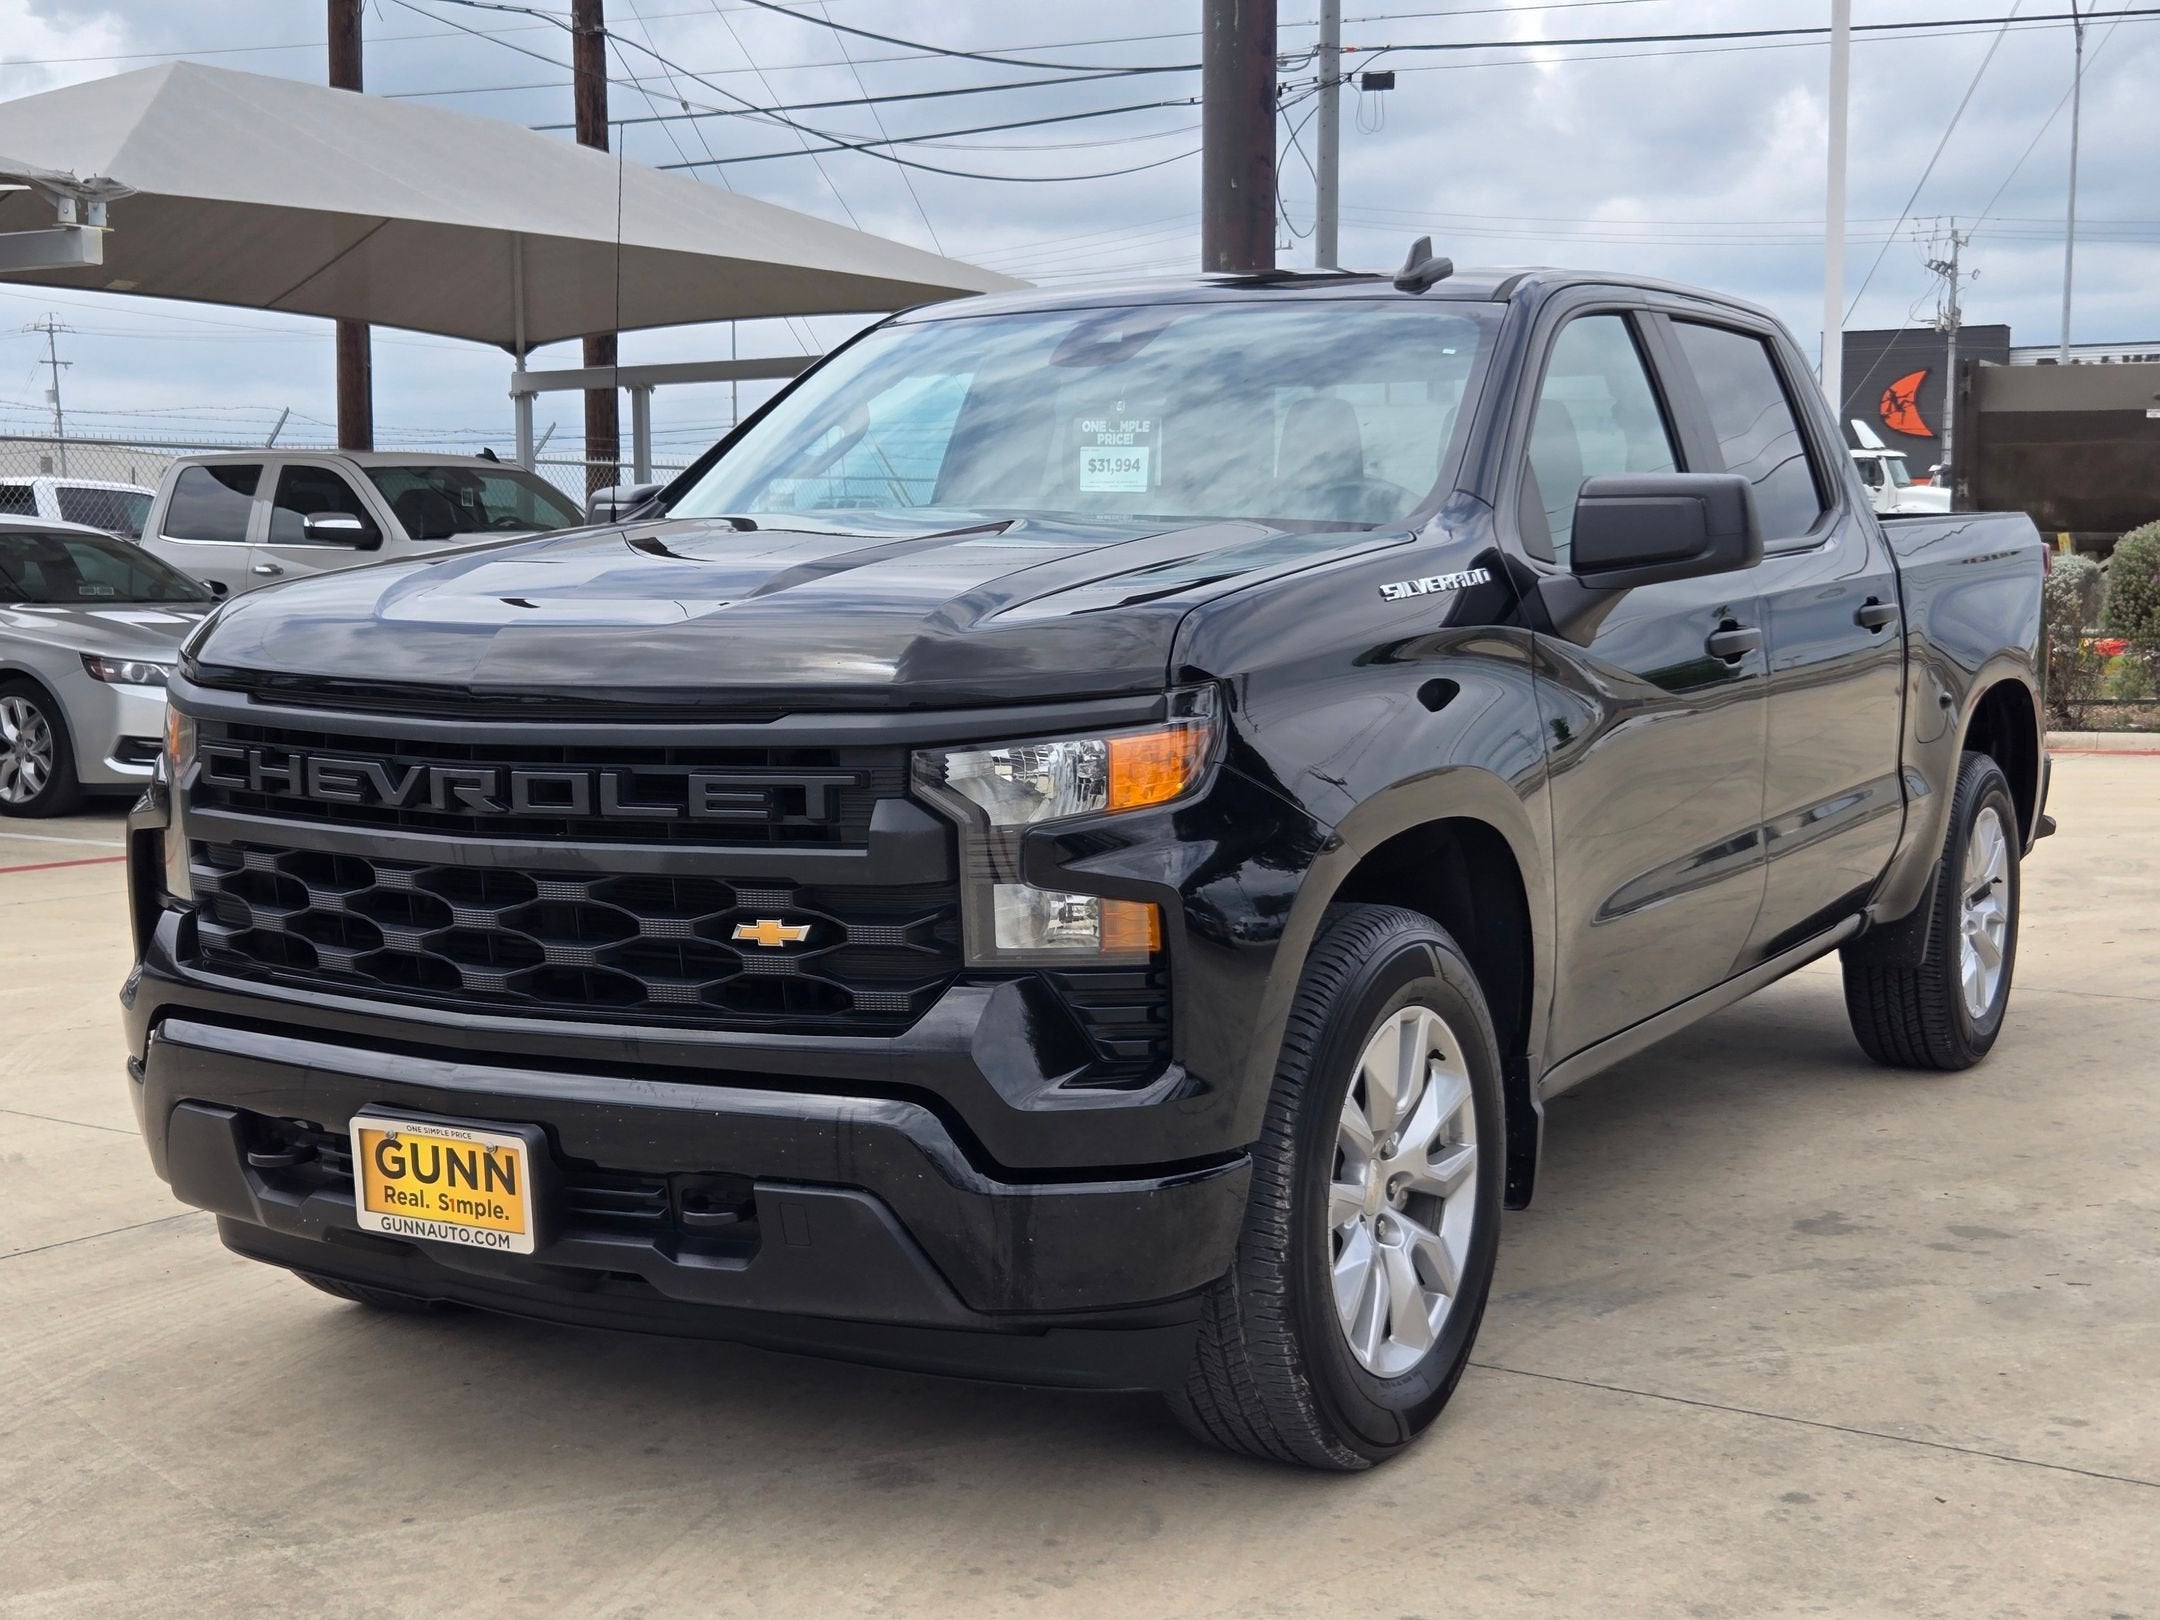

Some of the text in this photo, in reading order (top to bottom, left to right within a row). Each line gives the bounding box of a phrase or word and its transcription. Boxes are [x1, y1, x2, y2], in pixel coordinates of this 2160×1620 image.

[1081, 420, 1106, 433] ONE
[1088, 458, 1141, 475] $31,994
[1379, 567, 1492, 602] SILVERADO
[200, 743, 864, 822] CHEVROLET
[406, 1125, 472, 1140] ONE SIMPLE PRICE
[375, 1138, 516, 1196] GUNN
[384, 1185, 430, 1209] Real.
[381, 1216, 511, 1249] GUNNAUTO.COM
